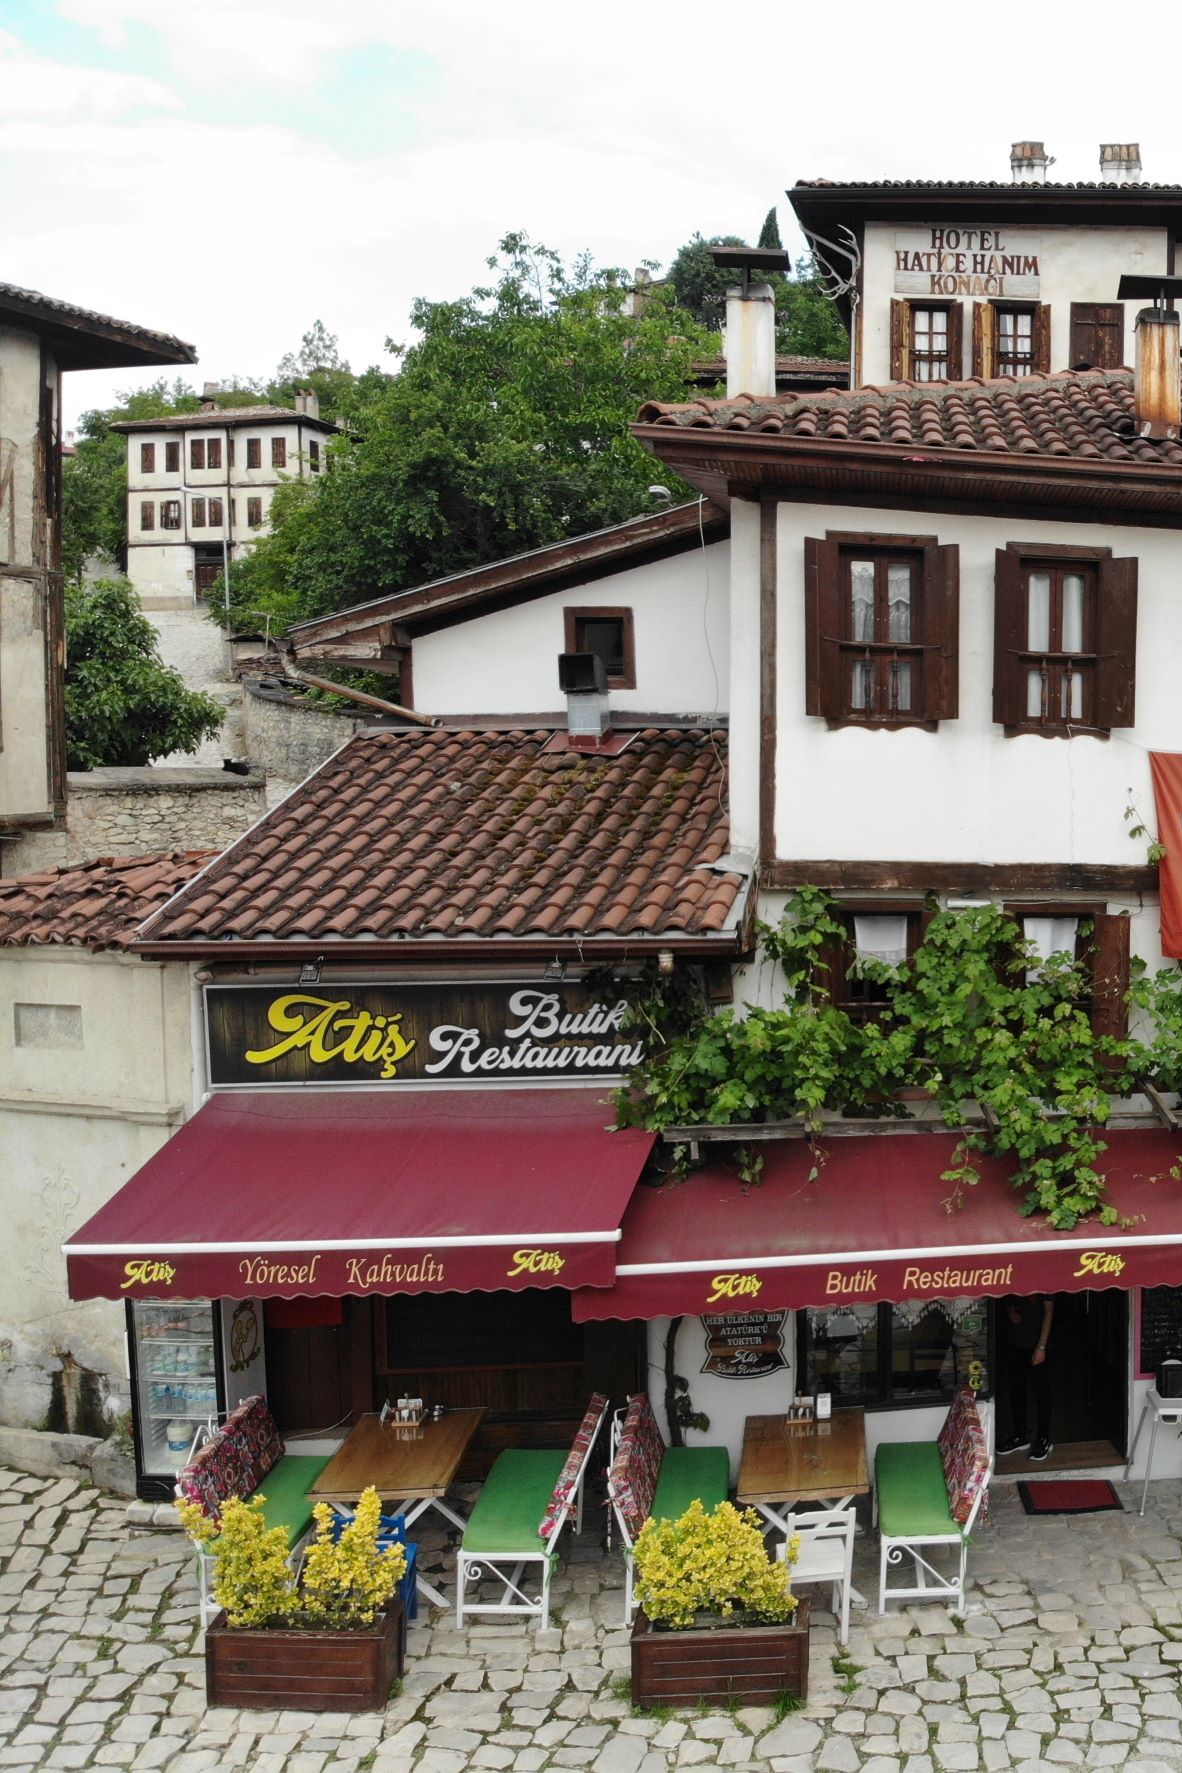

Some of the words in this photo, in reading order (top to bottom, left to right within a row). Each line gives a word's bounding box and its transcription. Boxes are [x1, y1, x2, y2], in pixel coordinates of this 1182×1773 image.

[930, 229, 1006, 252] HOTEL
[895, 249, 967, 274] HATİCE
[972, 253, 1041, 277] HANIM
[930, 274, 1005, 297] KONAĞI
[504, 989, 628, 1039] Butik
[245, 994, 416, 1079] Atiş
[424, 1024, 646, 1074] Restaurant
[120, 1259, 177, 1289] Atiş
[238, 1254, 322, 1285] Yöresel
[345, 1253, 446, 1287] Kahvaltı
[507, 1249, 567, 1277] Atiş
[825, 1269, 879, 1295] Butik
[902, 1263, 1014, 1290] Restaurant
[706, 1316, 725, 1325] HER
[727, 1336, 762, 1347] YOKTUR
